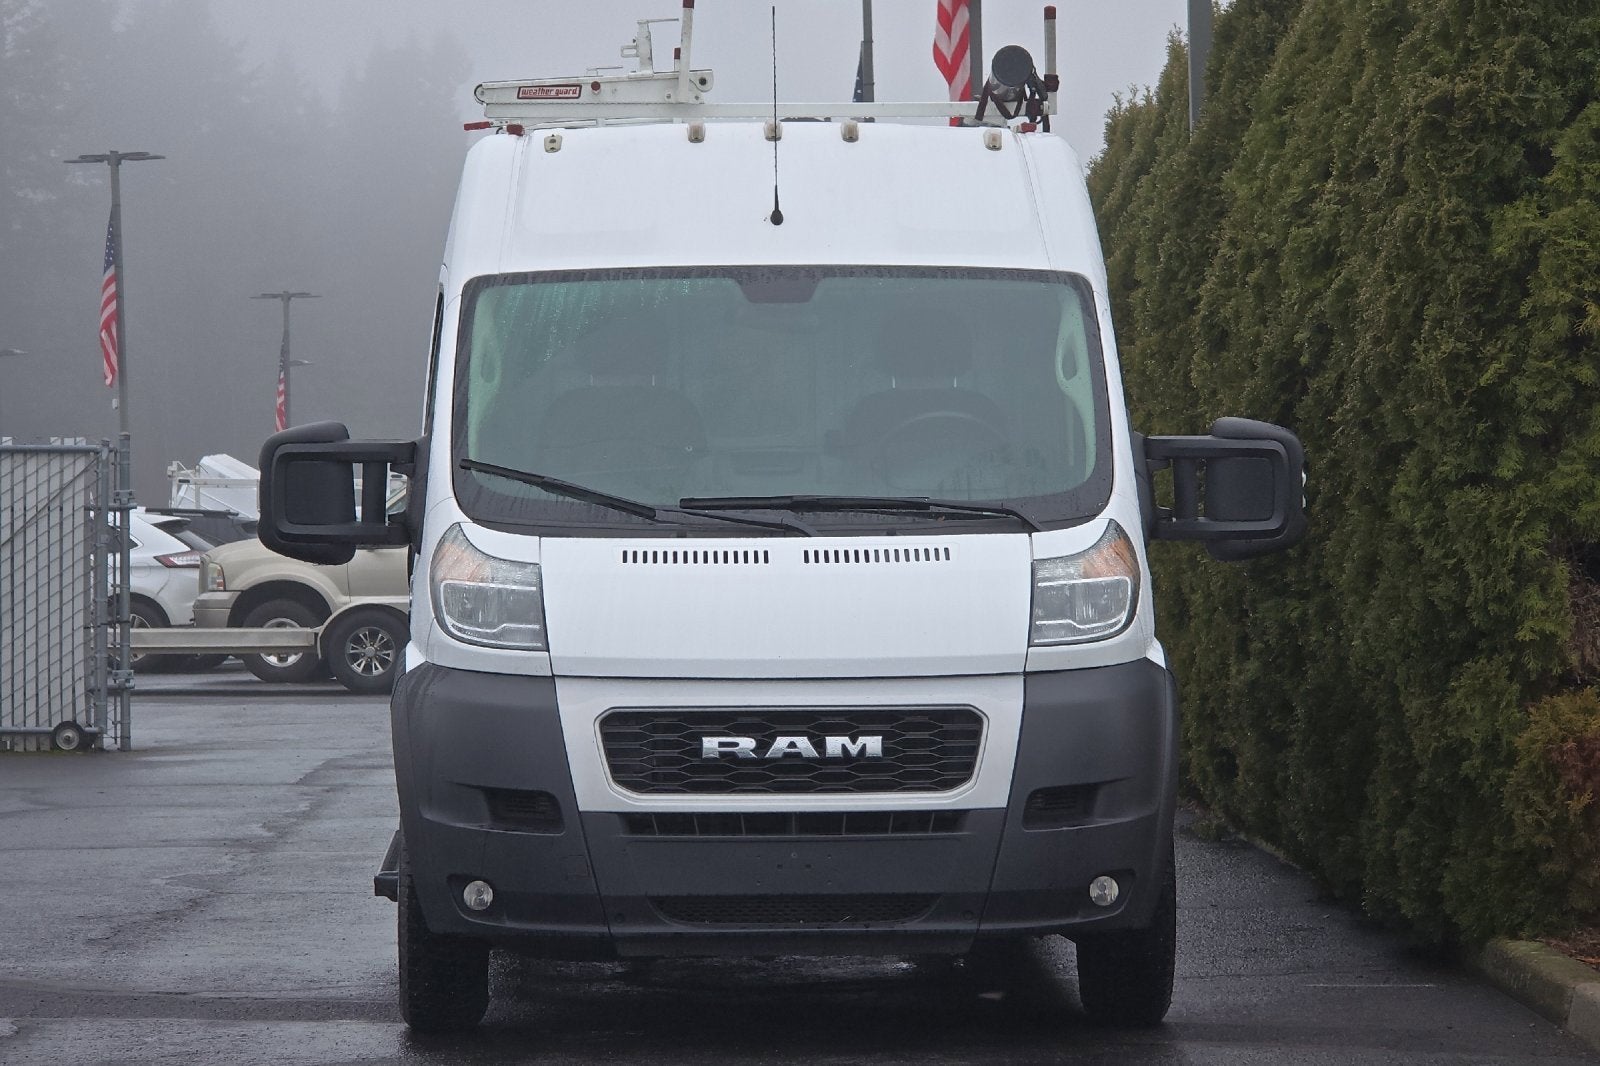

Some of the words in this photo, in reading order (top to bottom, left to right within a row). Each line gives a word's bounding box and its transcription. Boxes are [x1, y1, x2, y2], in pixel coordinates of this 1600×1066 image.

[521, 87, 554, 96] weather
[554, 87, 578, 97] guard
[702, 736, 883, 758] RAM
